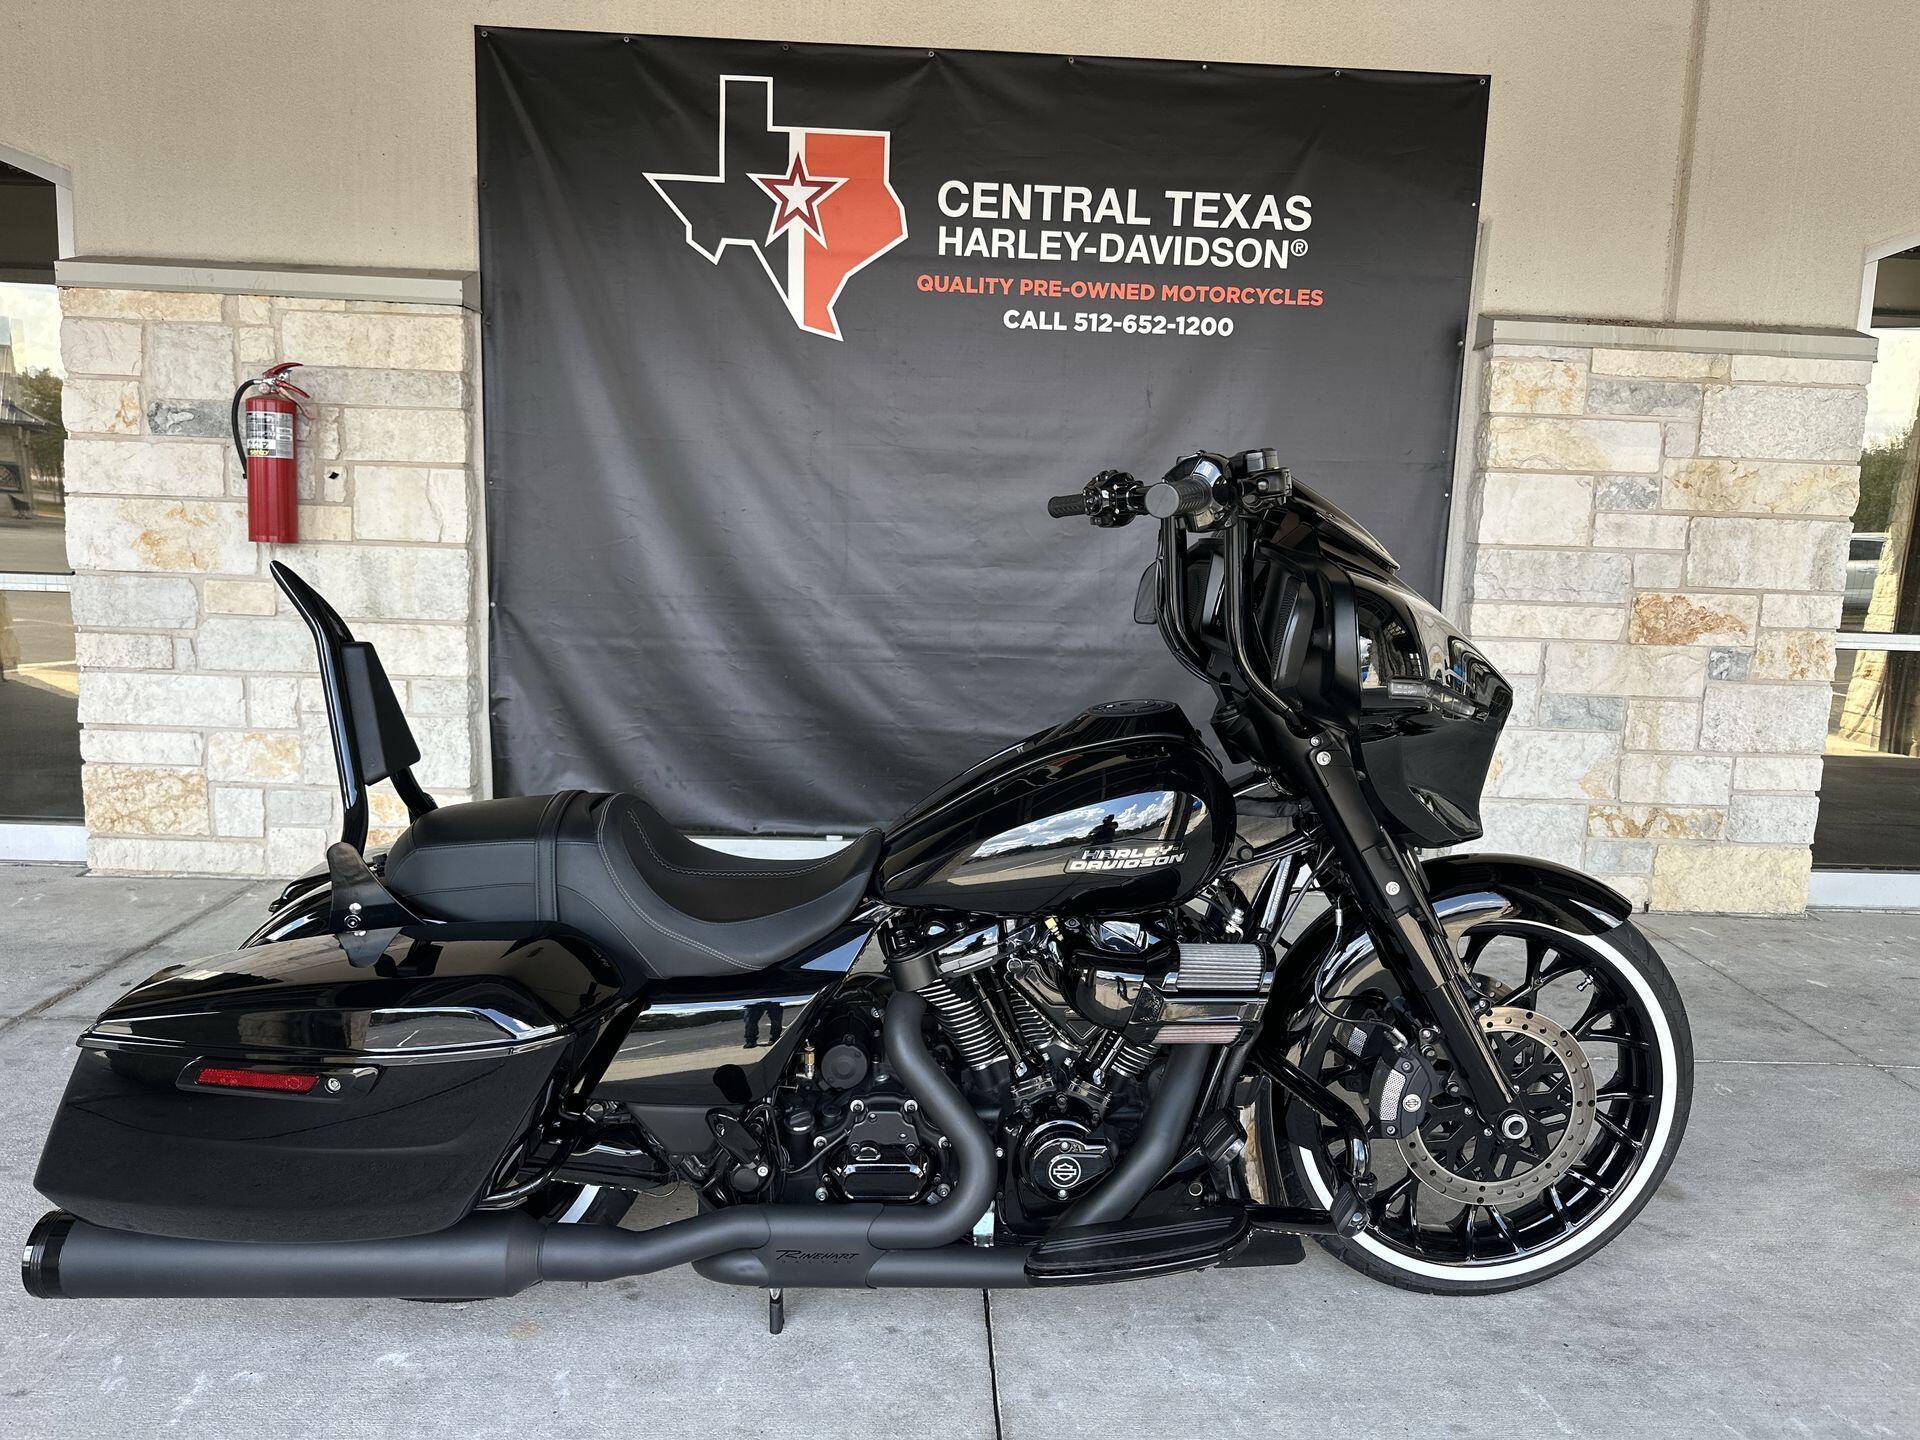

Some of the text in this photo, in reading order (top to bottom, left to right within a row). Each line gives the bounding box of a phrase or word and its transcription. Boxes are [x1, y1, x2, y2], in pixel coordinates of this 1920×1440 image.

[937, 179, 1312, 232] CENTRAL TEXAS
[916, 274, 1324, 306] QUALITY PRE-OWNED MOTORCYCLES
[1002, 309, 1235, 337] CALL 512-652-1200
[1069, 852, 1185, 871] DAVIDSON
